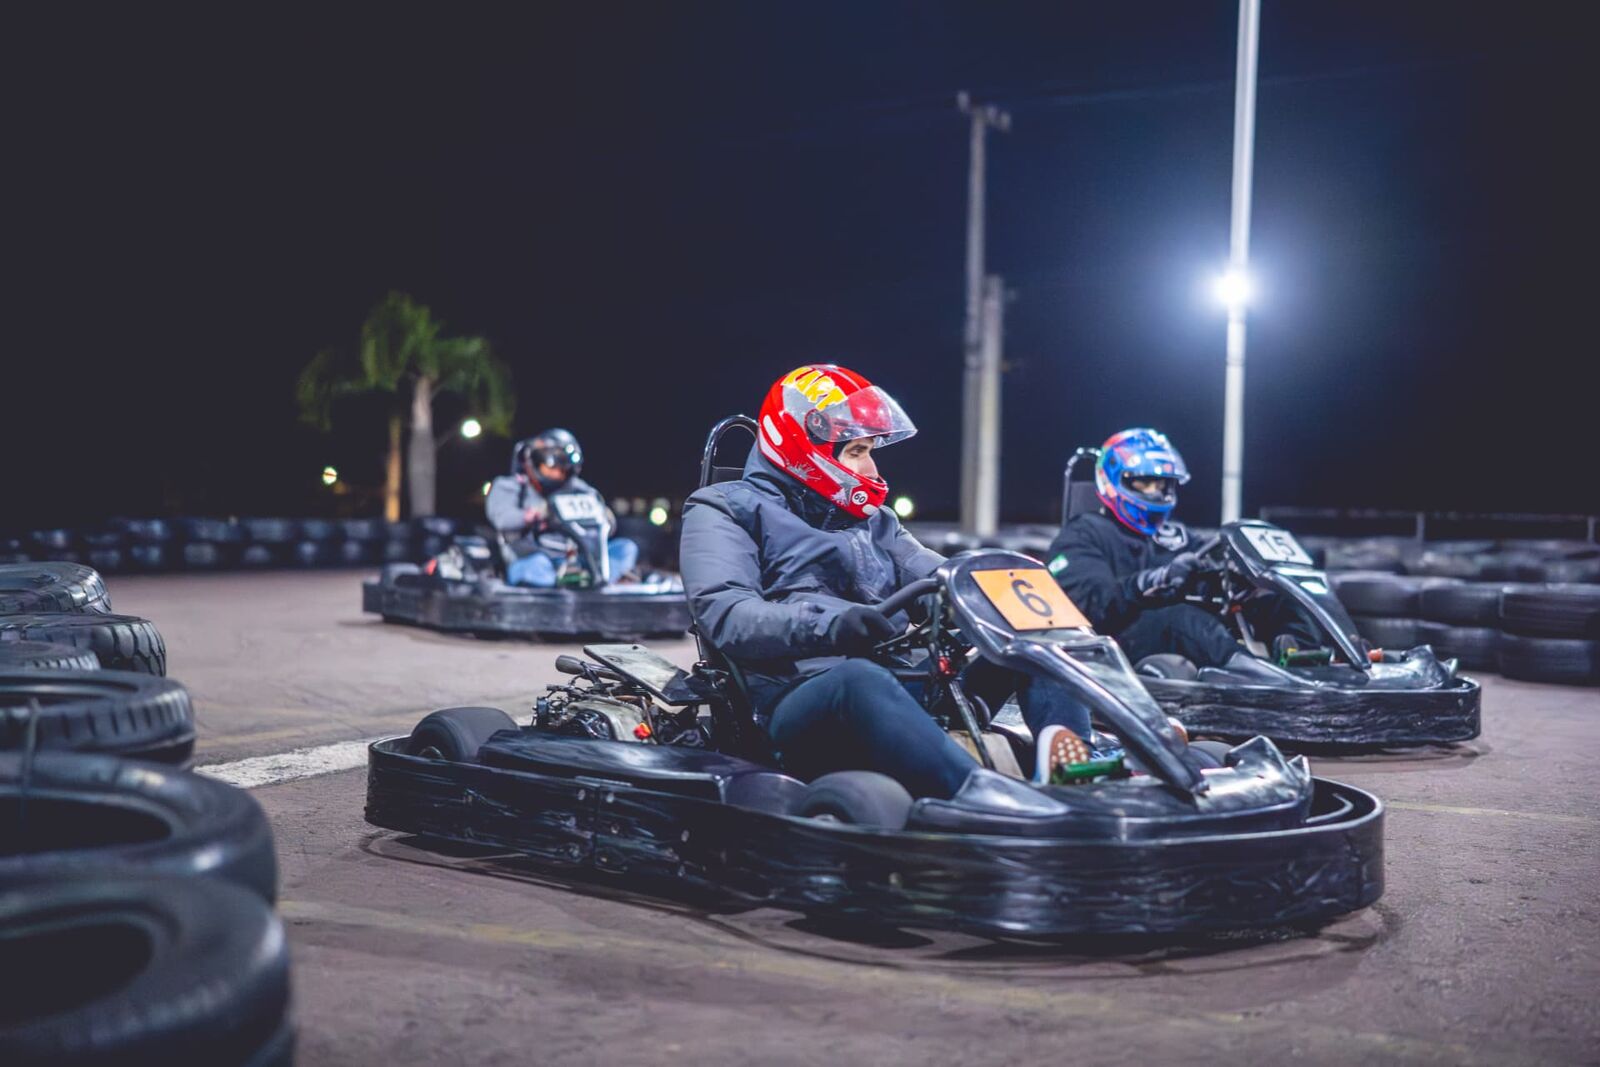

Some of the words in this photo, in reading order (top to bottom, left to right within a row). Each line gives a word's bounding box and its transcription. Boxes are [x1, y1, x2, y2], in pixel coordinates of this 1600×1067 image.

[854, 492, 866, 503] 60
[1258, 534, 1296, 556] 15
[1010, 579, 1053, 617] 6
